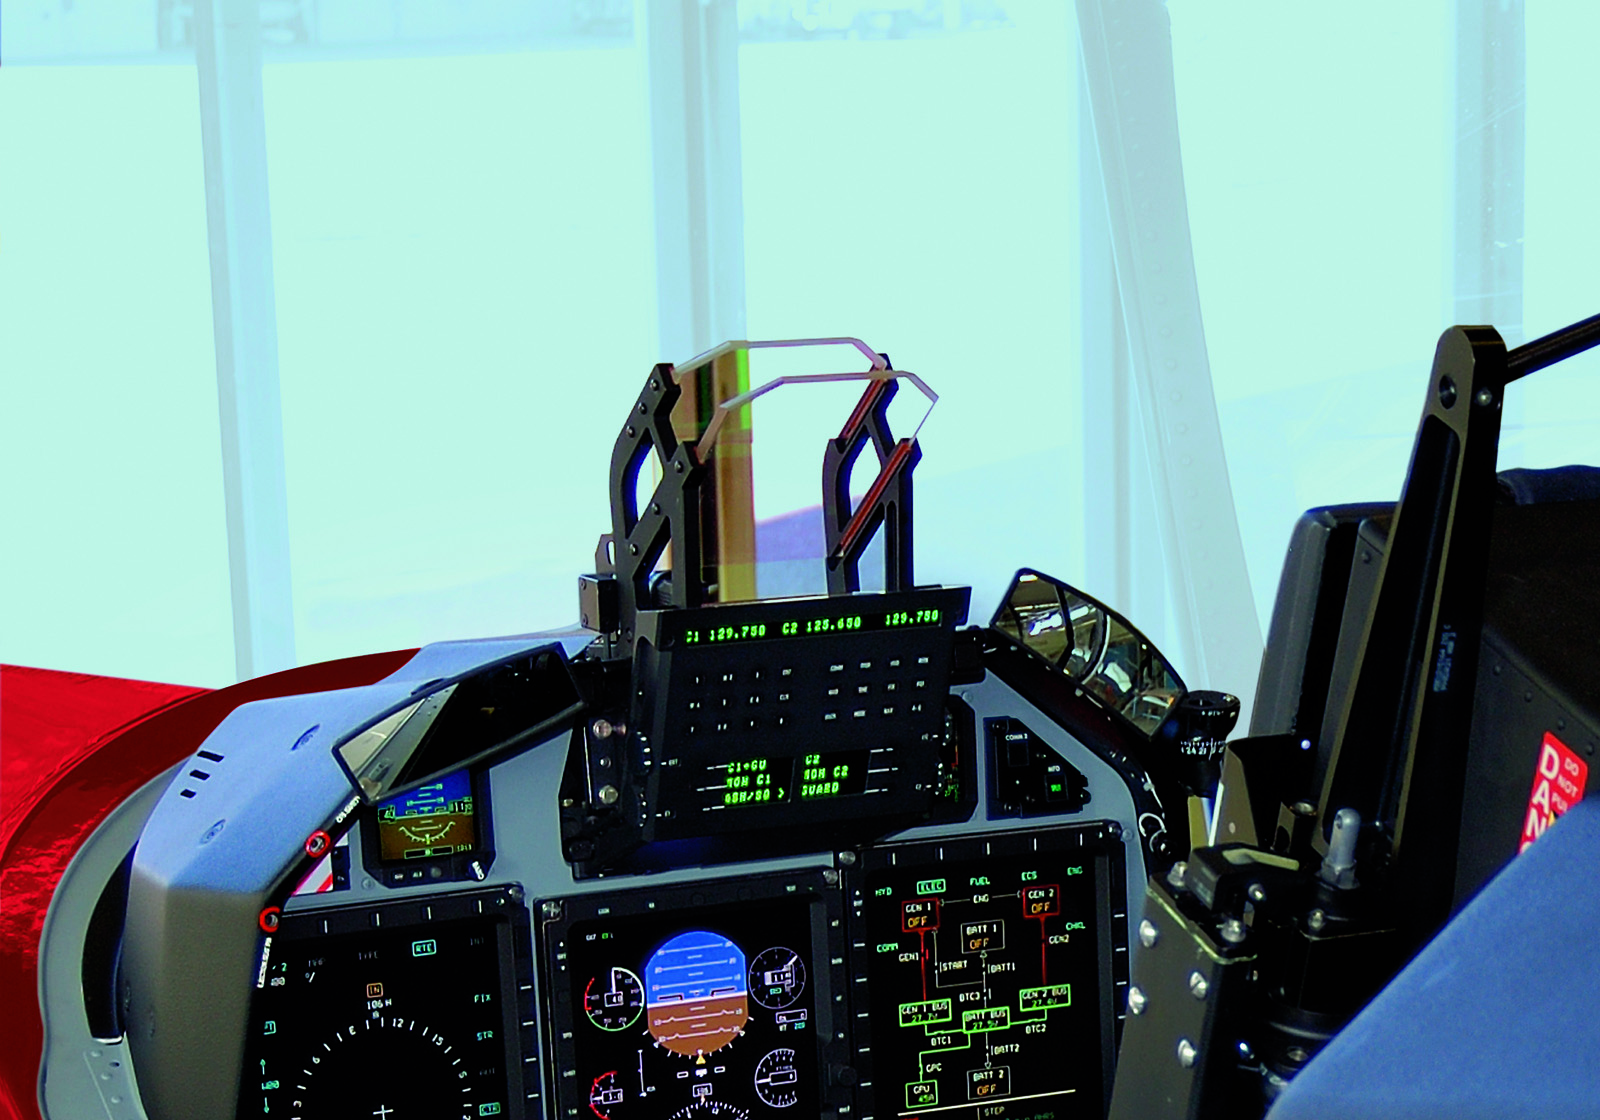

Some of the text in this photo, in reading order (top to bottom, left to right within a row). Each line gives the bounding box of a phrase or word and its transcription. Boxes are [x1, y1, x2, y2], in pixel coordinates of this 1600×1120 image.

[710, 625, 765, 641] 129.750
[783, 622, 797, 634] C2
[886, 610, 938, 625] 129.750
[834, 766, 848, 777] C2
[1564, 758, 1579, 777] DO
[757, 774, 770, 784] C1
[1557, 774, 1578, 797] NOT
[970, 877, 990, 886] FUEL
[1021, 871, 1037, 881] ECS
[921, 881, 942, 892] ELEC
[1031, 903, 1050, 913] OFF
[908, 916, 927, 927] OFF
[970, 938, 989, 949] OFF
[474, 994, 491, 1003] FIX
[392, 1018, 404, 1027] 12
[432, 1034, 444, 1045] 15
